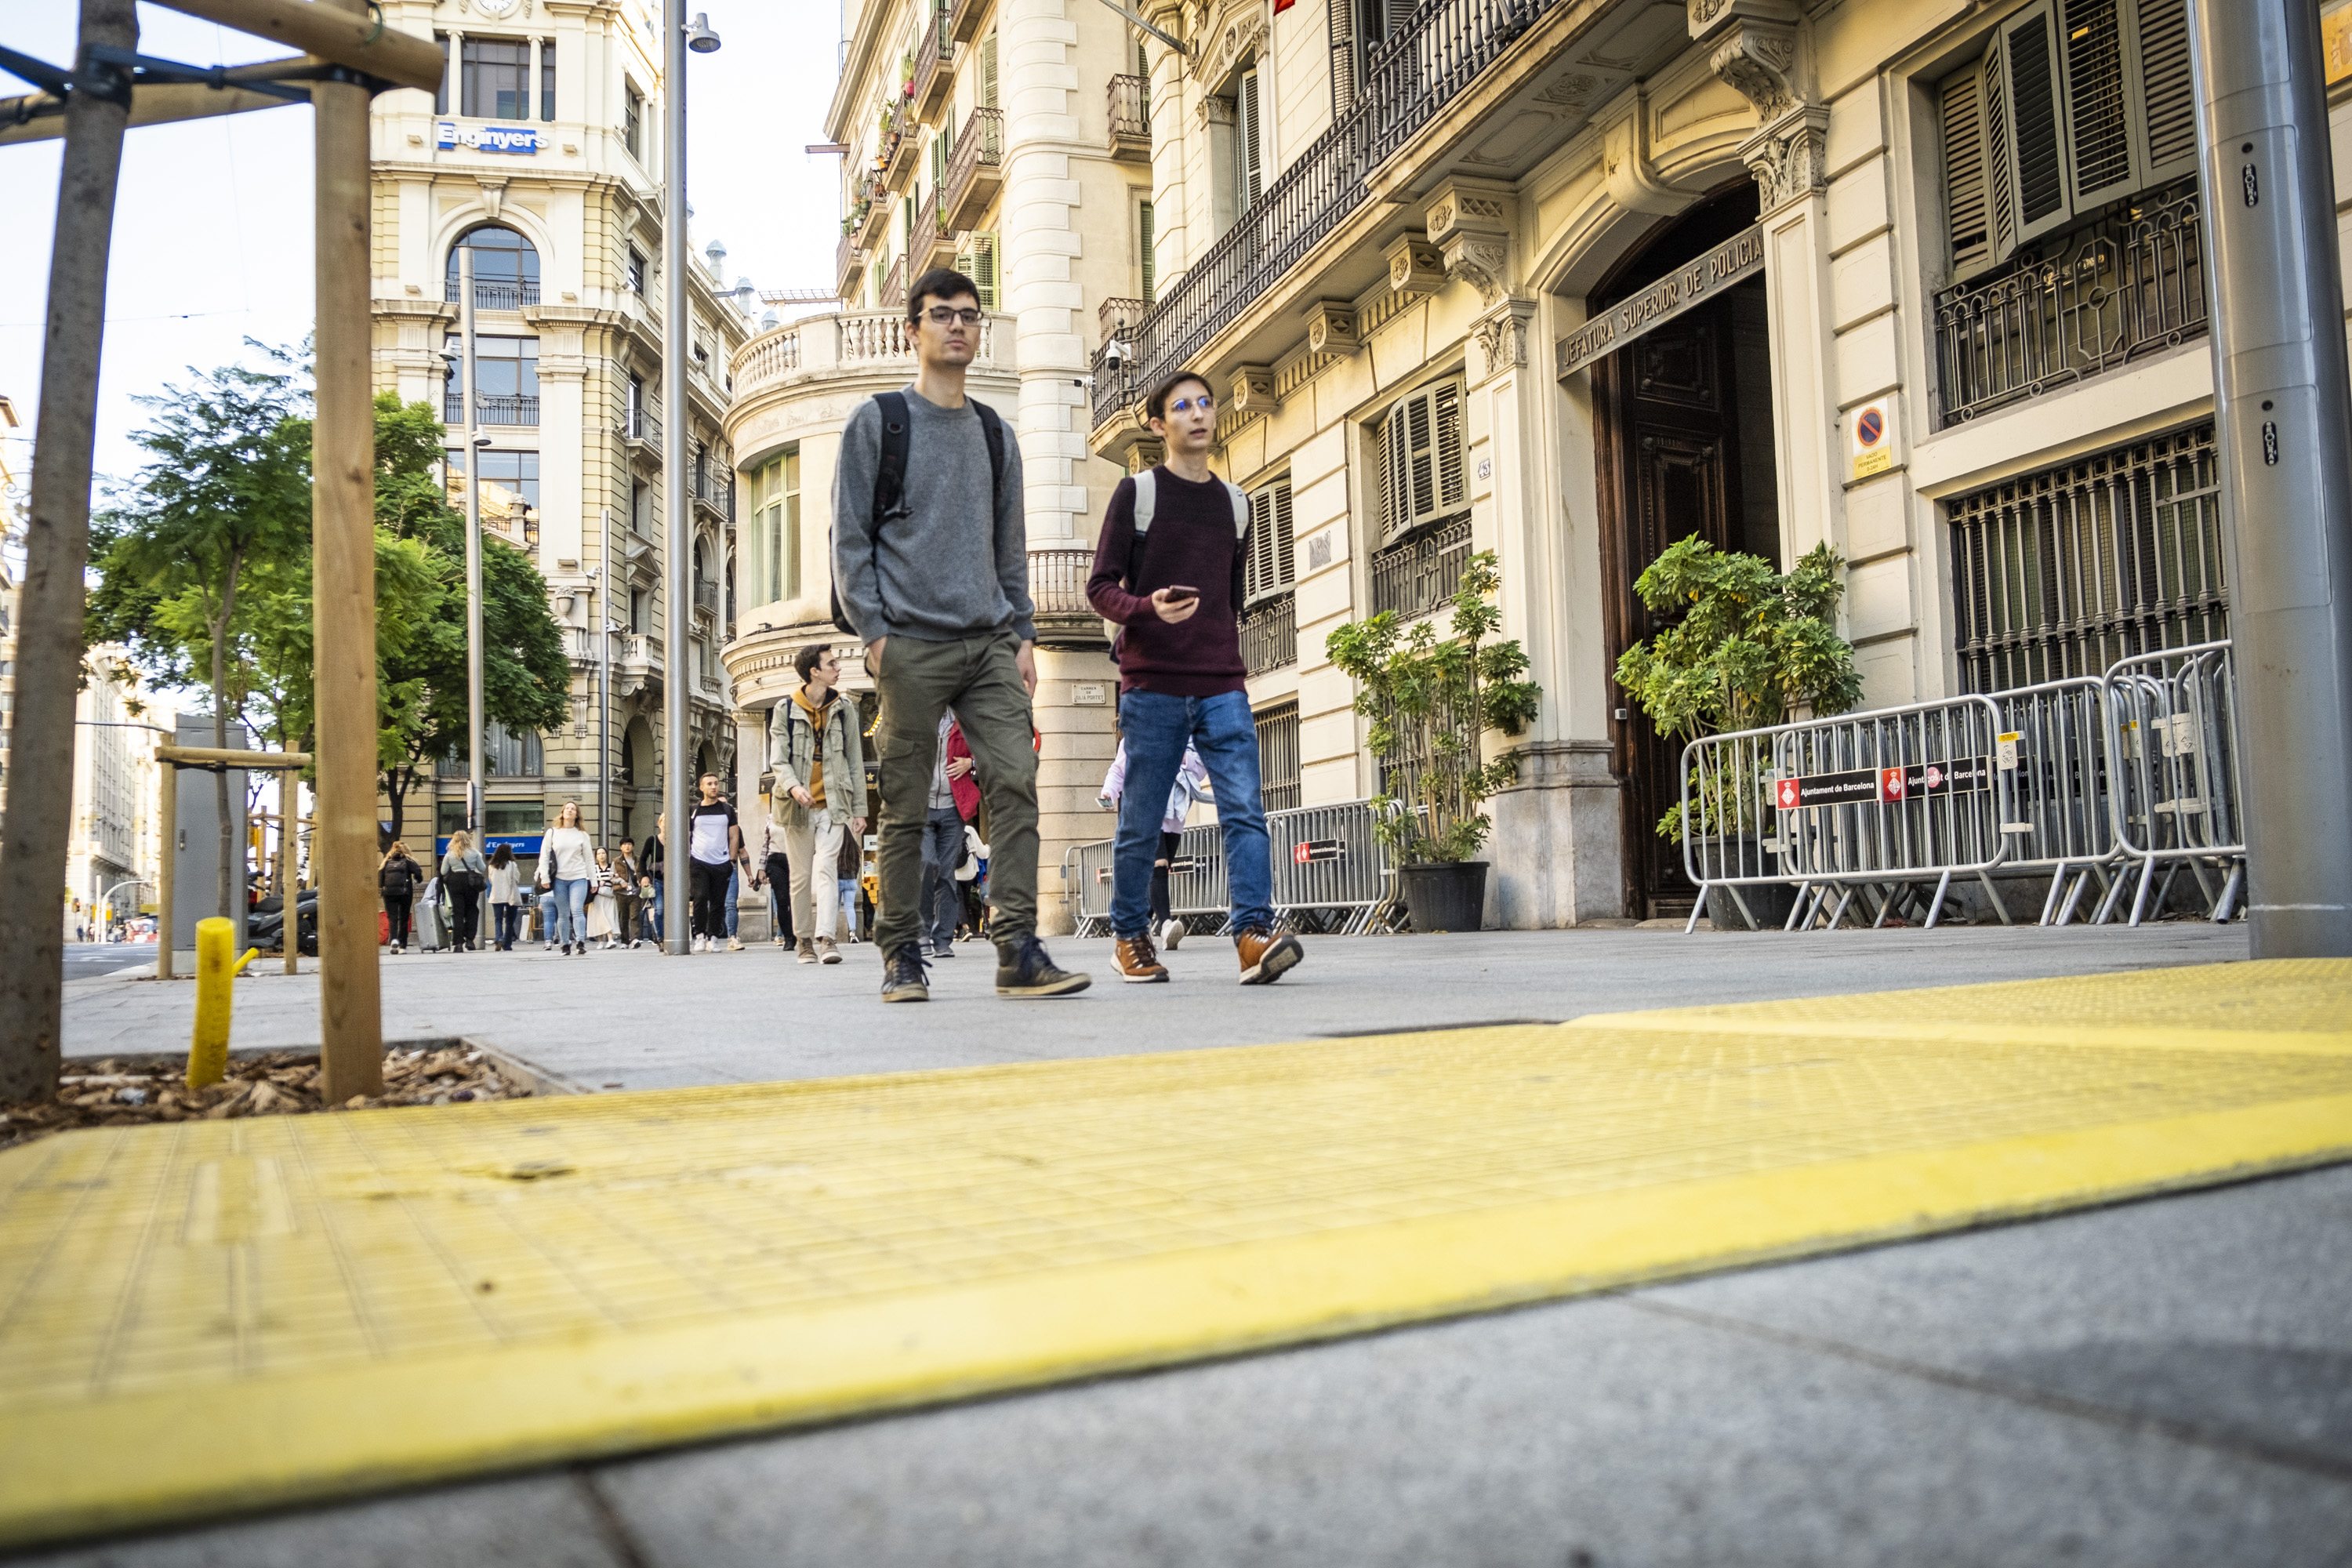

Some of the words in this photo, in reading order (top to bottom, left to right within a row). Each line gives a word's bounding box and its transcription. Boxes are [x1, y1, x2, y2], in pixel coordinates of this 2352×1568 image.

[438, 125, 549, 149] Enginyers
[1563, 318, 1615, 366] JEFATURA
[1621, 281, 1679, 332] SUPERIOR
[1686, 266, 1703, 297] DE
[1710, 235, 1762, 284] POLICIA
[1857, 454, 1886, 469] PERMANENTE
[1800, 786, 1834, 797] Ajuntament
[1835, 784, 1842, 793] de
[1843, 782, 1875, 792] Barcelona
